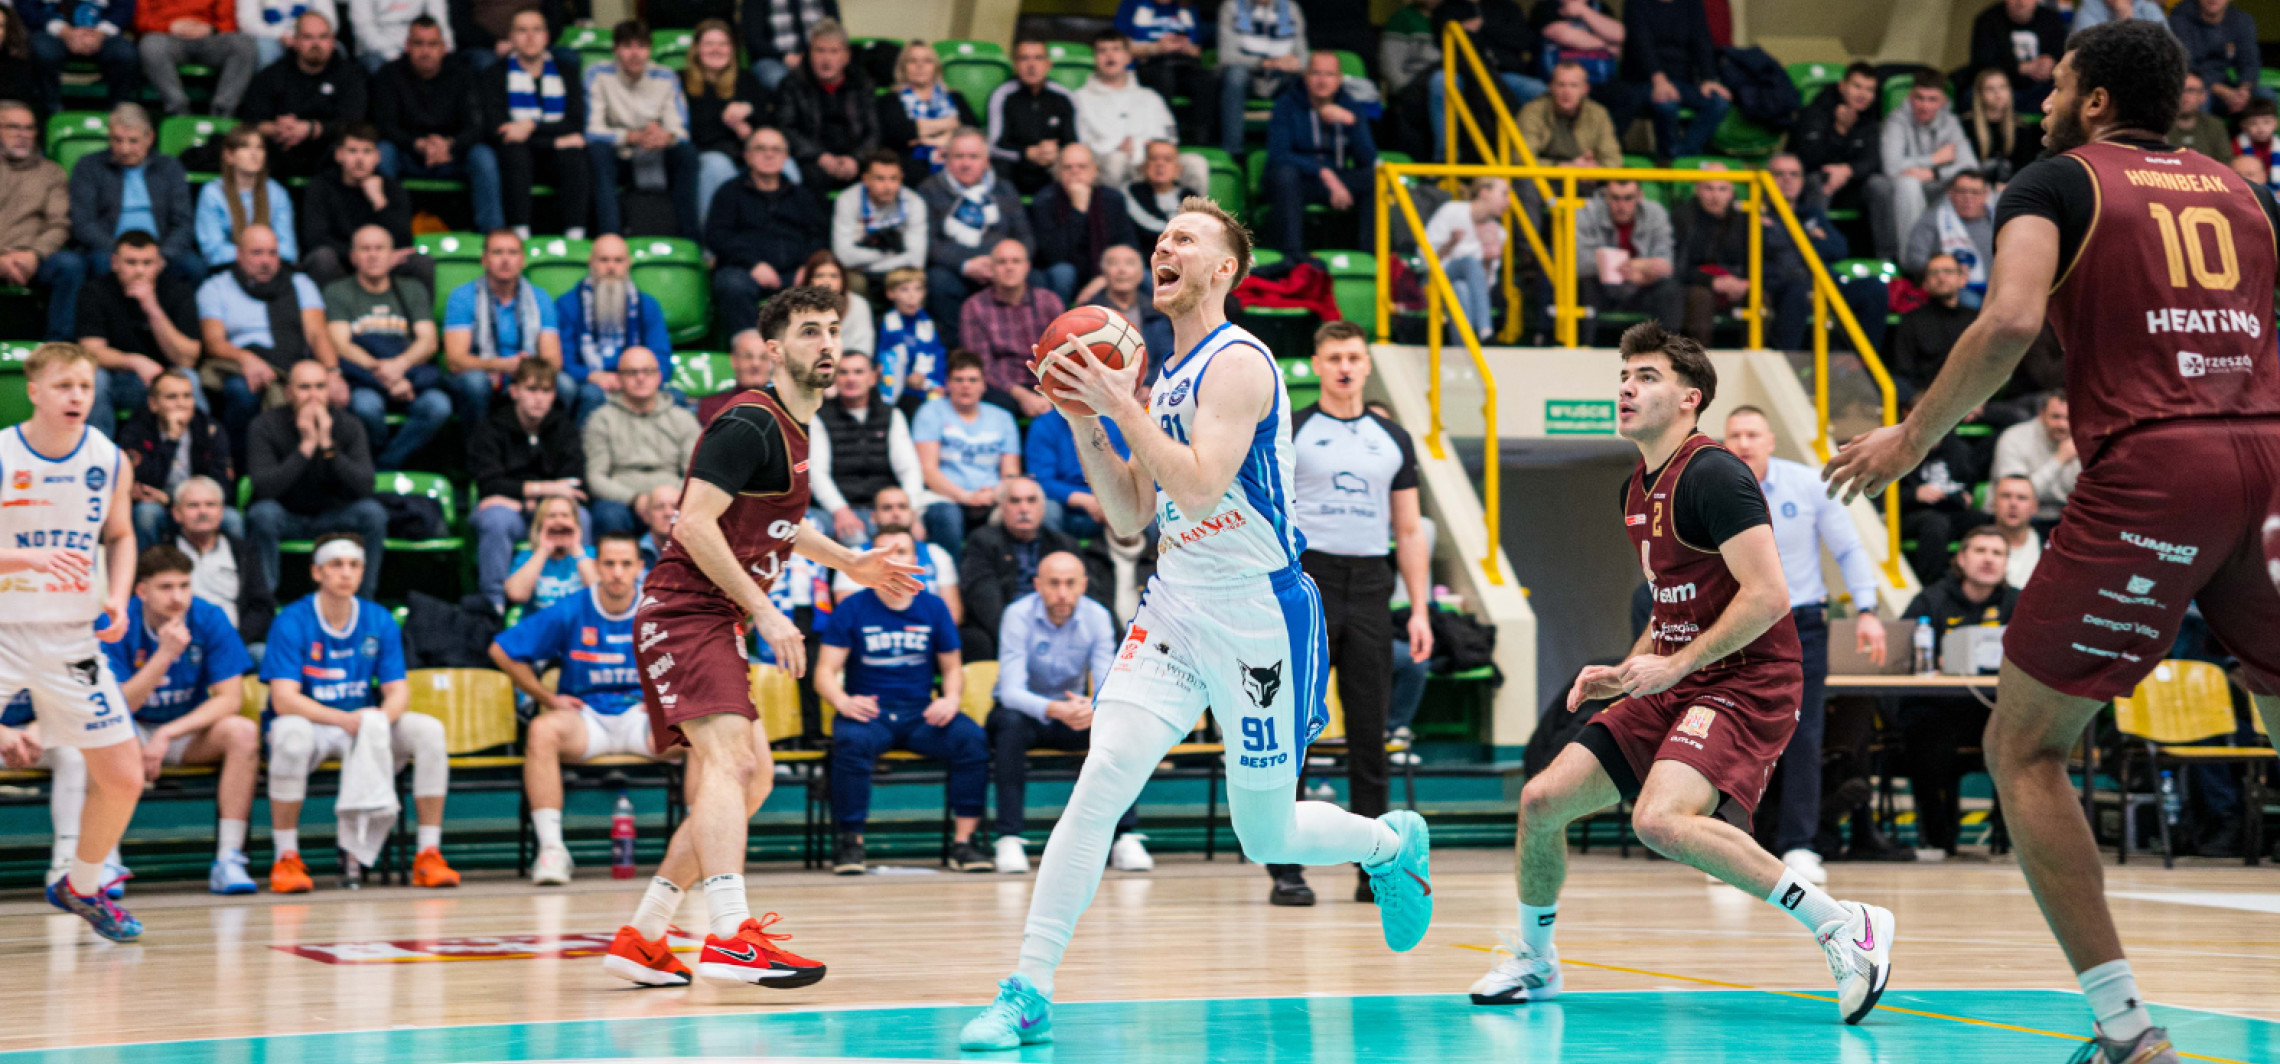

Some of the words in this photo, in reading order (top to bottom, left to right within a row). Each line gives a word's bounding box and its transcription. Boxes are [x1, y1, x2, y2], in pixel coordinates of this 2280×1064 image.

[2124, 168, 2231, 193] HORNBEAK
[2147, 202, 2241, 291] 10
[86, 496, 102, 523] 3
[1652, 501, 1663, 538] 2
[15, 529, 93, 551] NOTEC
[2120, 531, 2199, 556] KUMHO
[865, 631, 929, 653] NOTEC
[89, 691, 111, 717] 3
[1241, 716, 1279, 752] 91
[1240, 752, 1288, 768] BESTO
